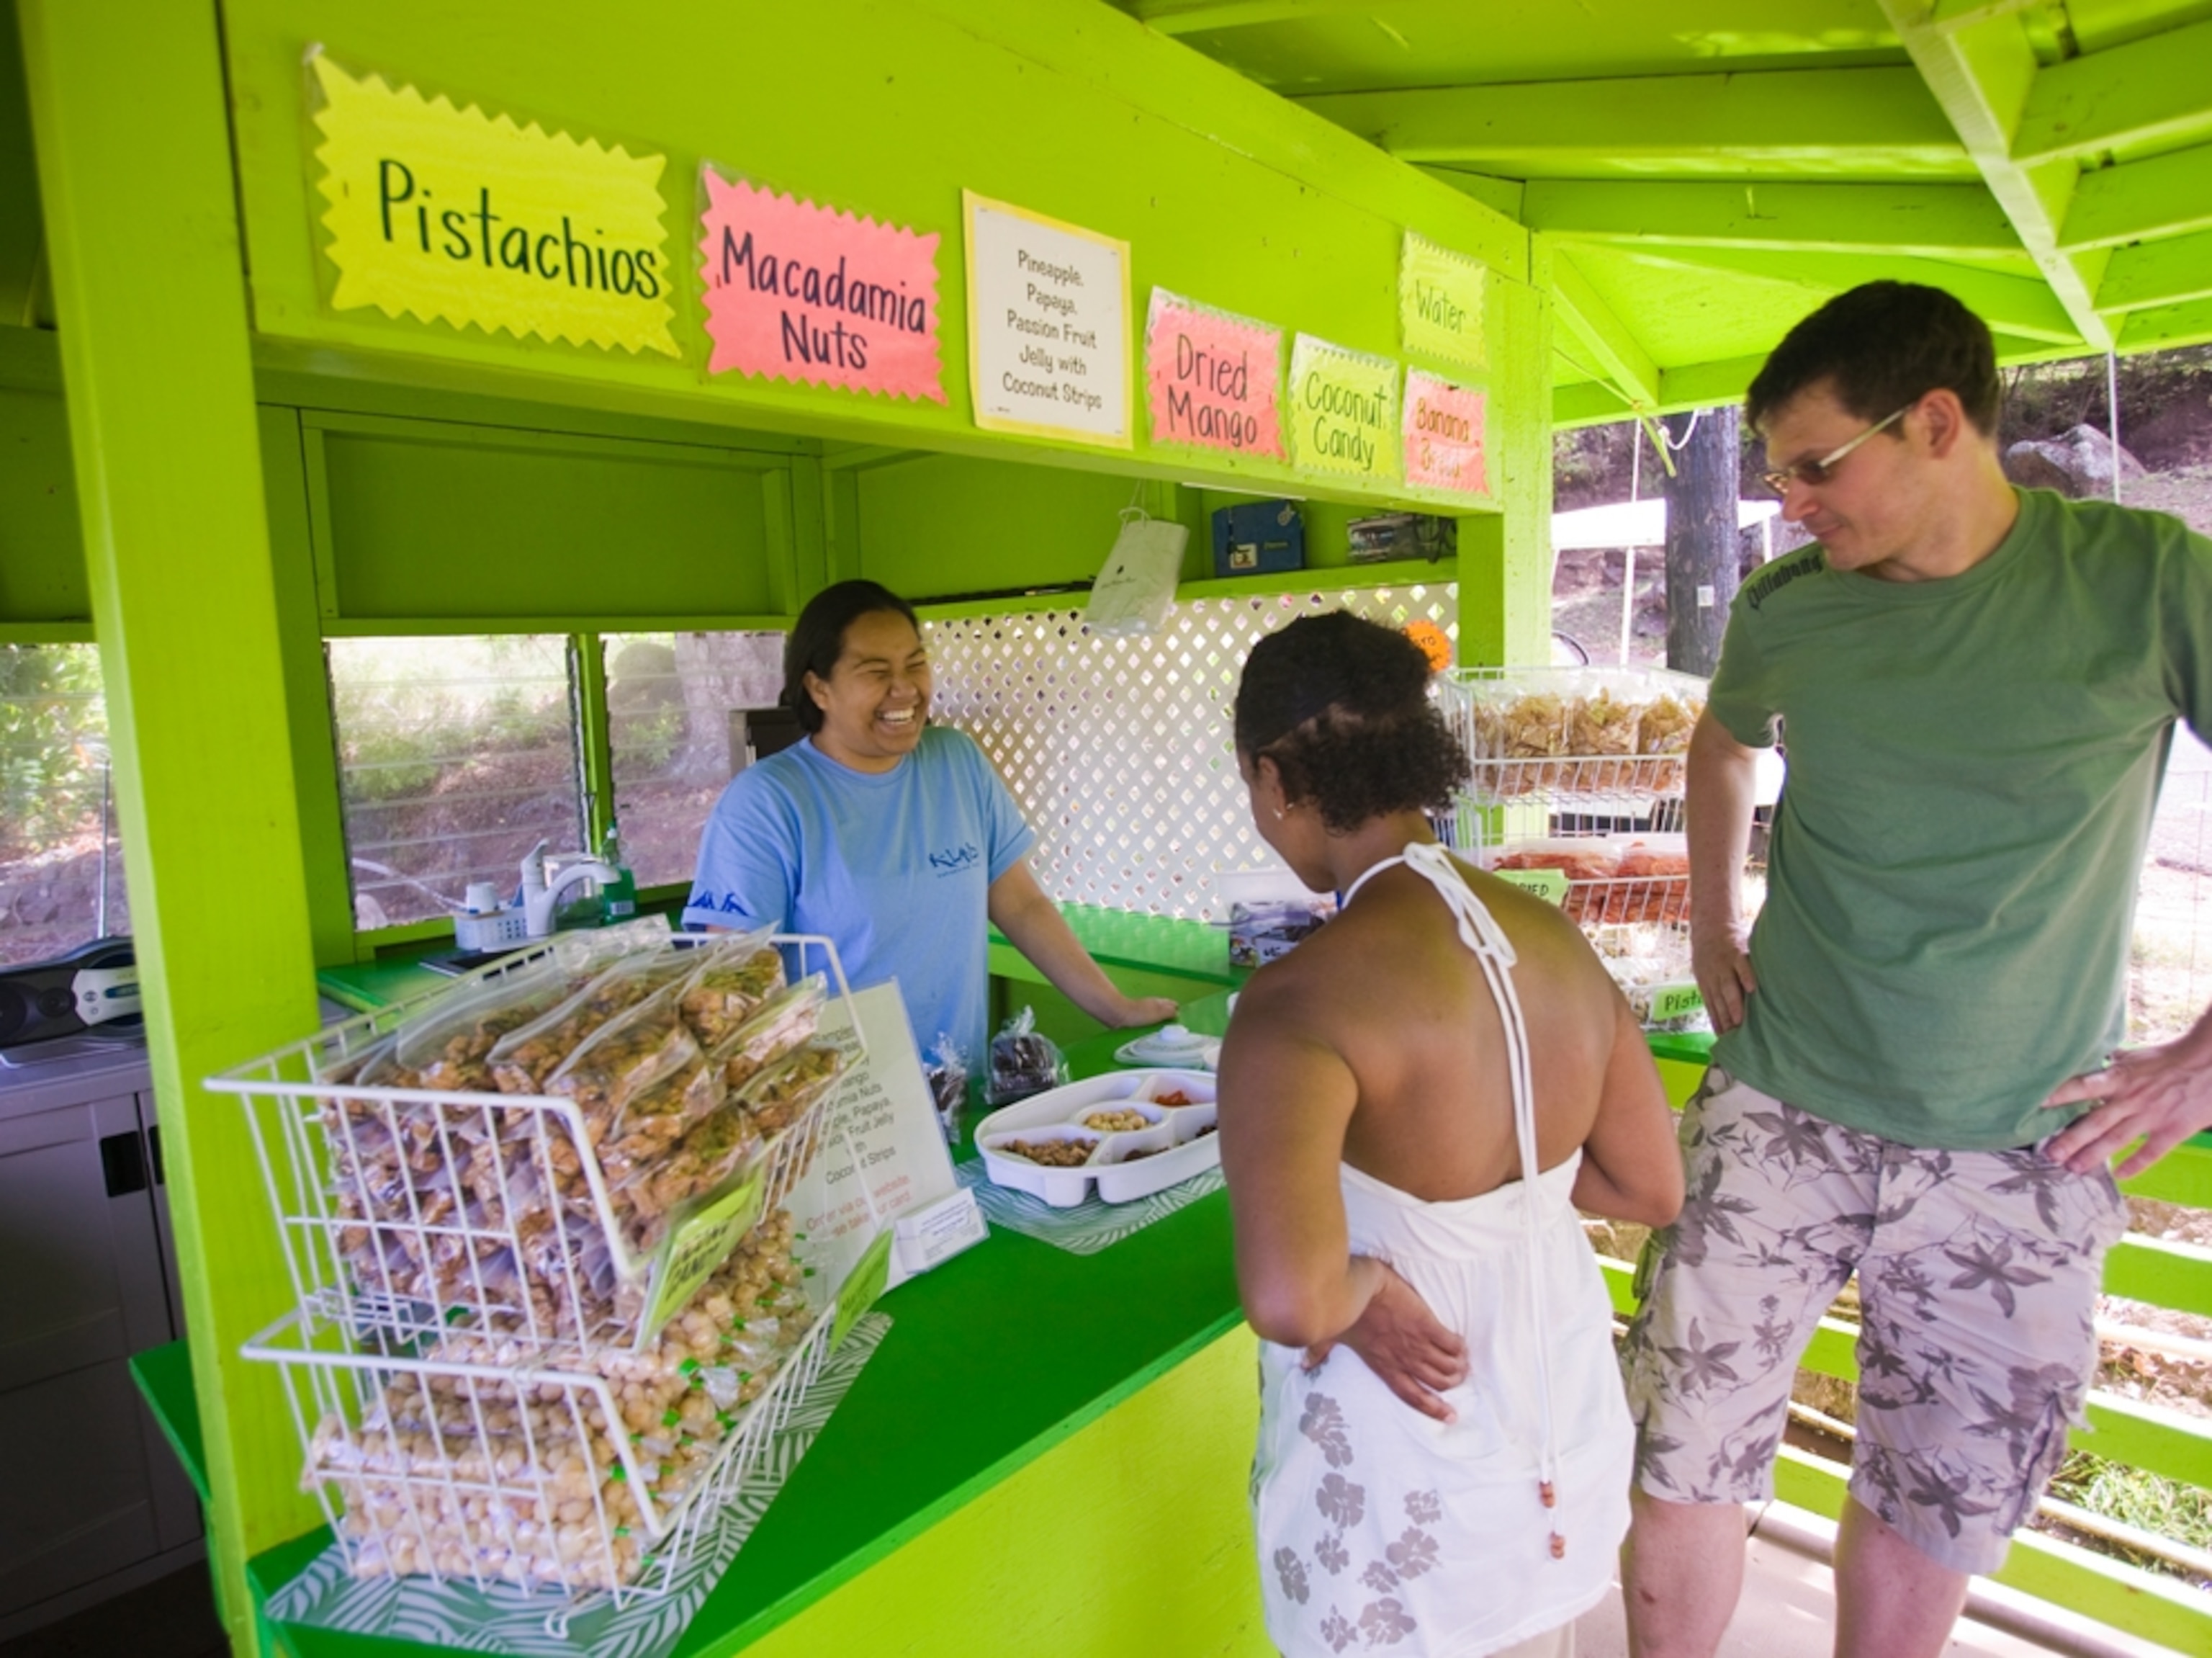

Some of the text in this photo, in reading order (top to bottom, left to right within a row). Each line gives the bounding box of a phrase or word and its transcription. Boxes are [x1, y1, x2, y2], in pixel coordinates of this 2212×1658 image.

[379, 160, 660, 299] Pistachios
[721, 226, 926, 334] Macadamia
[1416, 279, 1466, 333] Water
[781, 311, 868, 369] Nuts
[1007, 309, 1097, 349] Passion Fruit
[1019, 344, 1087, 375] Jelly with
[1177, 333, 1247, 402] Dried
[1002, 370, 1102, 412] Coconut Strips
[1167, 384, 1257, 448] Mango
[1306, 371, 1388, 430] Coconut
[1313, 416, 1375, 472] Candy
[1416, 397, 1470, 443] Banana
